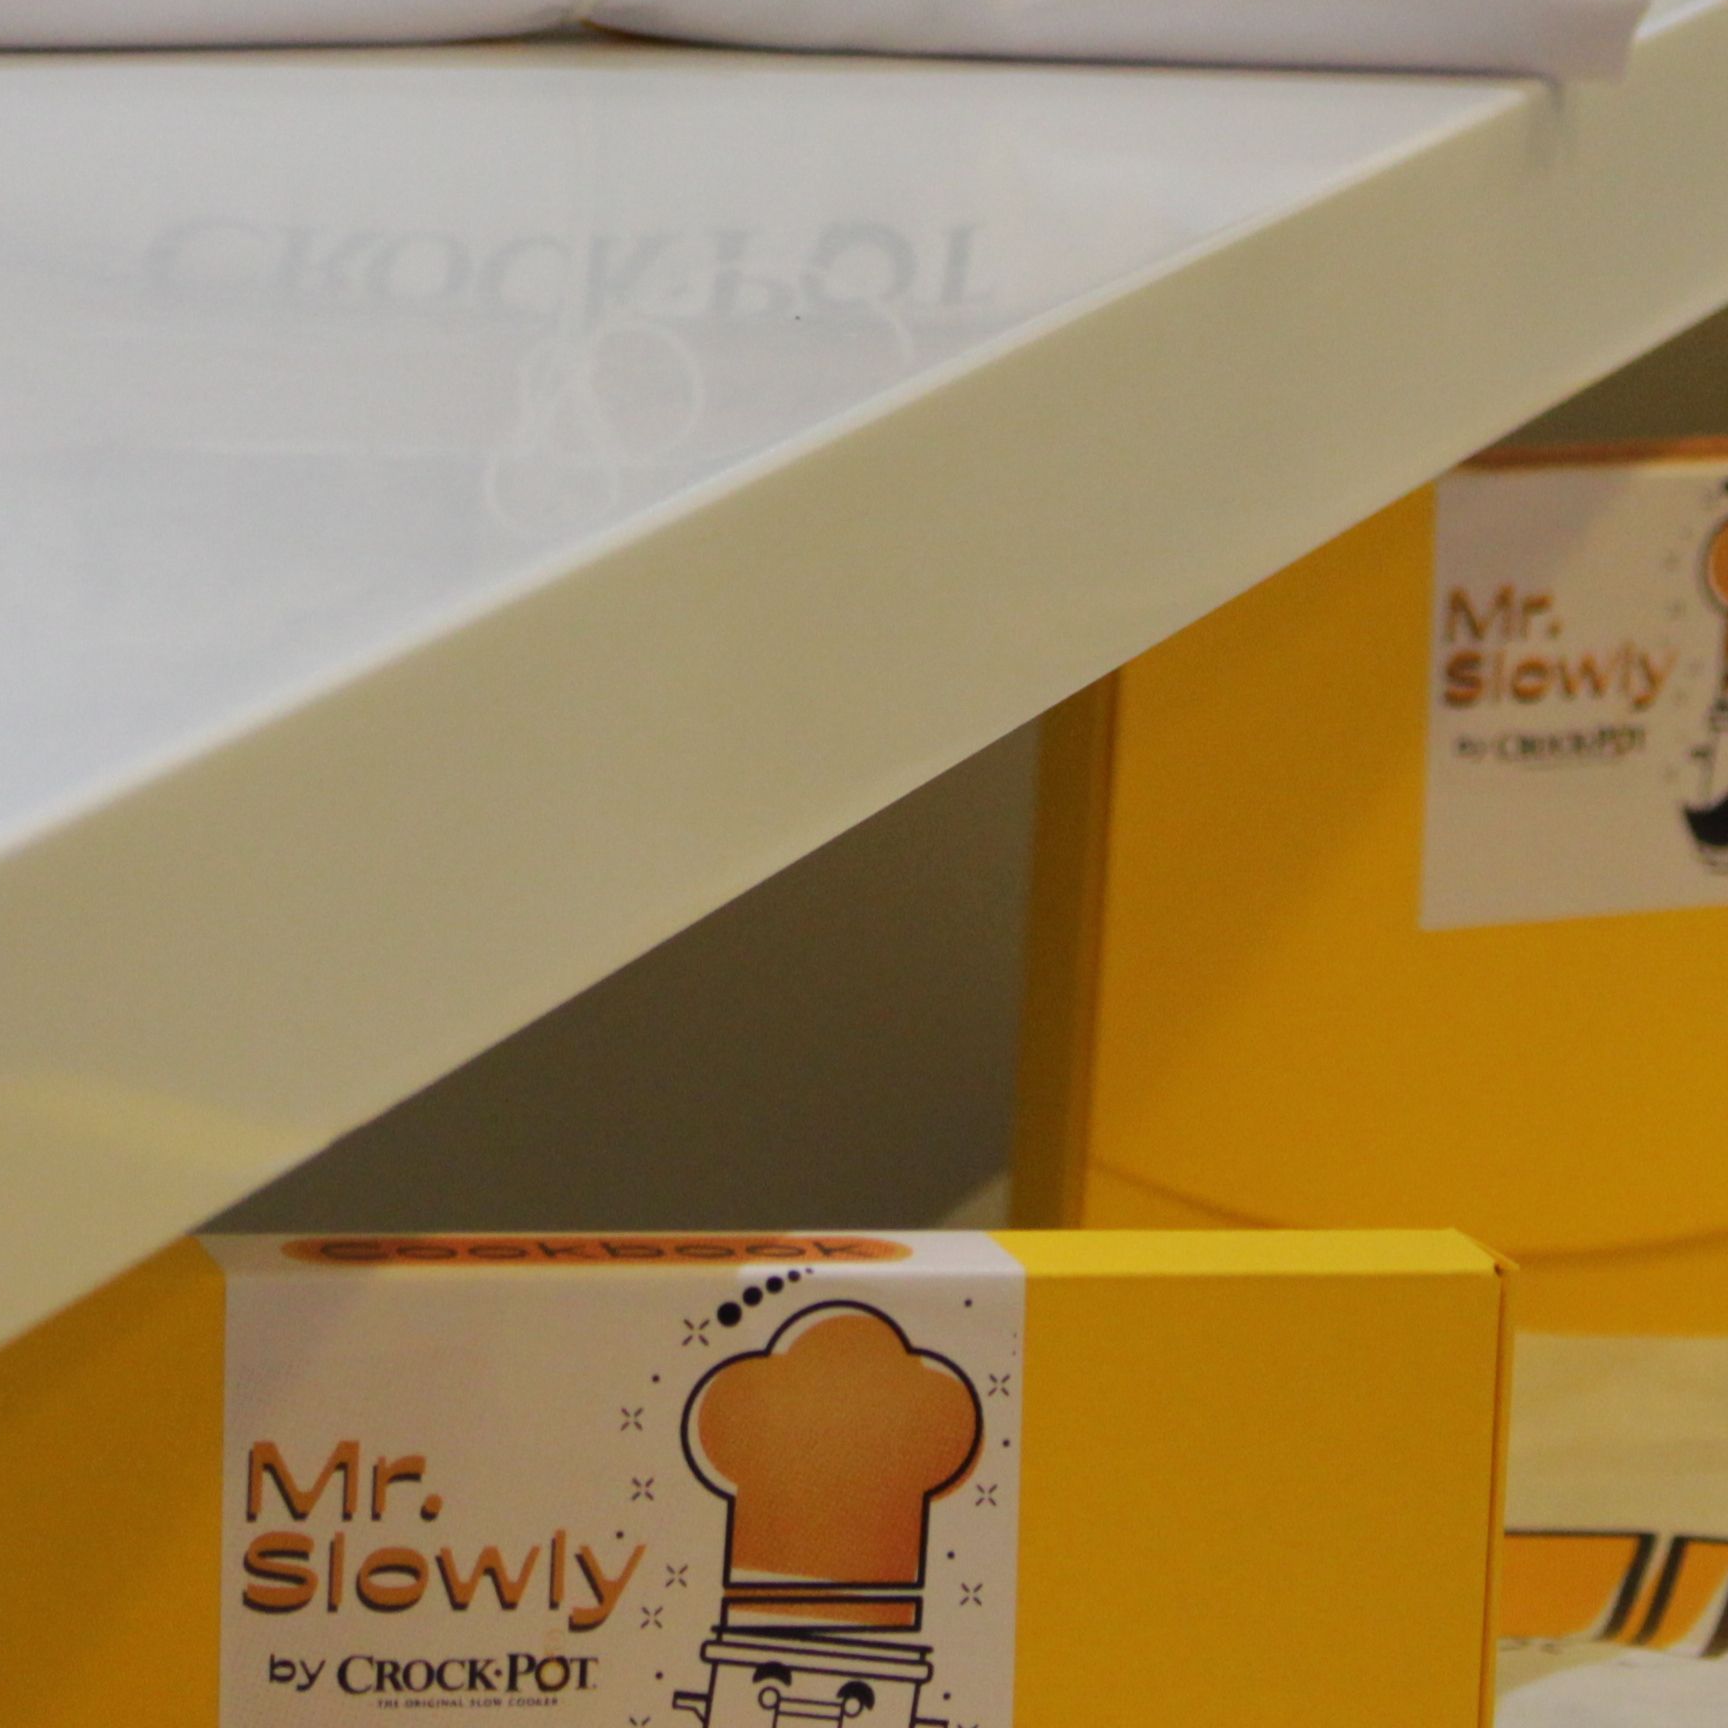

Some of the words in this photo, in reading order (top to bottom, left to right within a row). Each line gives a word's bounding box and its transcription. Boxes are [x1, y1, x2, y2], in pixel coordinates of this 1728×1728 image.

[1444, 583, 1562, 642] Mr.
[1444, 644, 1674, 710] Slowly
[246, 1440, 443, 1522] Mr.
[242, 1528, 647, 1633] Slowly
[269, 1653, 326, 1692] by
[376, 1699, 399, 1709] THE
[404, 1697, 464, 1709] ORIGINAL
[470, 1697, 503, 1708] SLOW
[508, 1696, 559, 1708] COOKER
